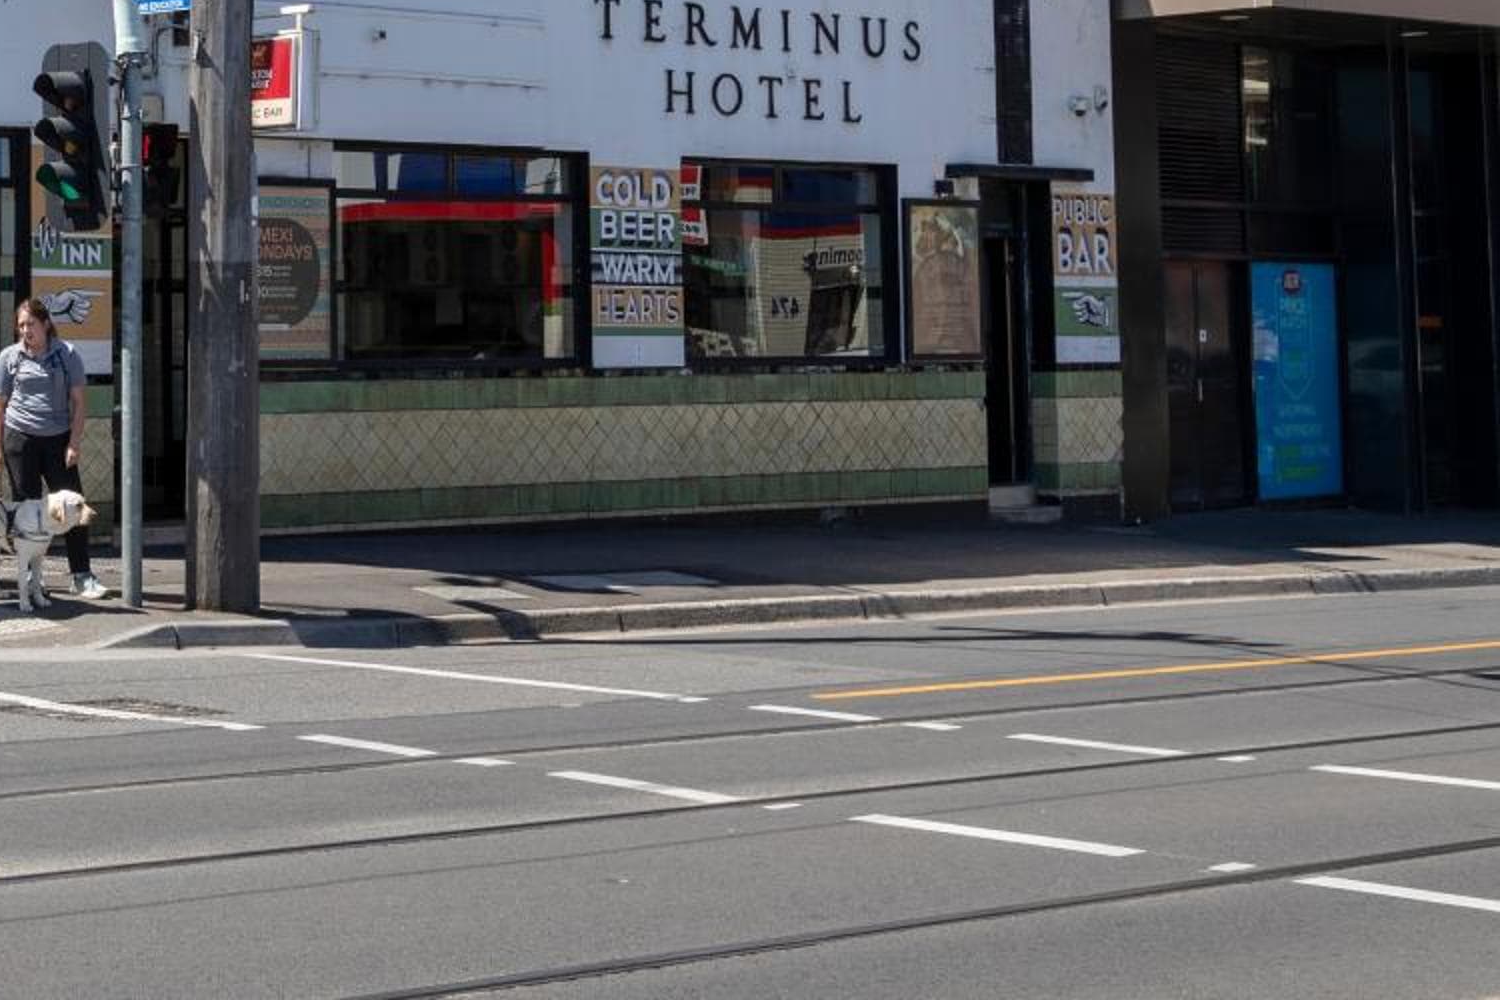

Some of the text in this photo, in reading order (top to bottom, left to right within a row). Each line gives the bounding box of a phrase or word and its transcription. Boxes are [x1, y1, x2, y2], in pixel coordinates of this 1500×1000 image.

[665, 69, 863, 124] HOTEL
[596, 171, 673, 208] COLD
[600, 210, 676, 244] BEER
[1052, 196, 1112, 226] PUBLIC
[1057, 228, 1111, 274] BAR
[600, 252, 676, 285] WARM
[597, 289, 679, 323] HEARTS
